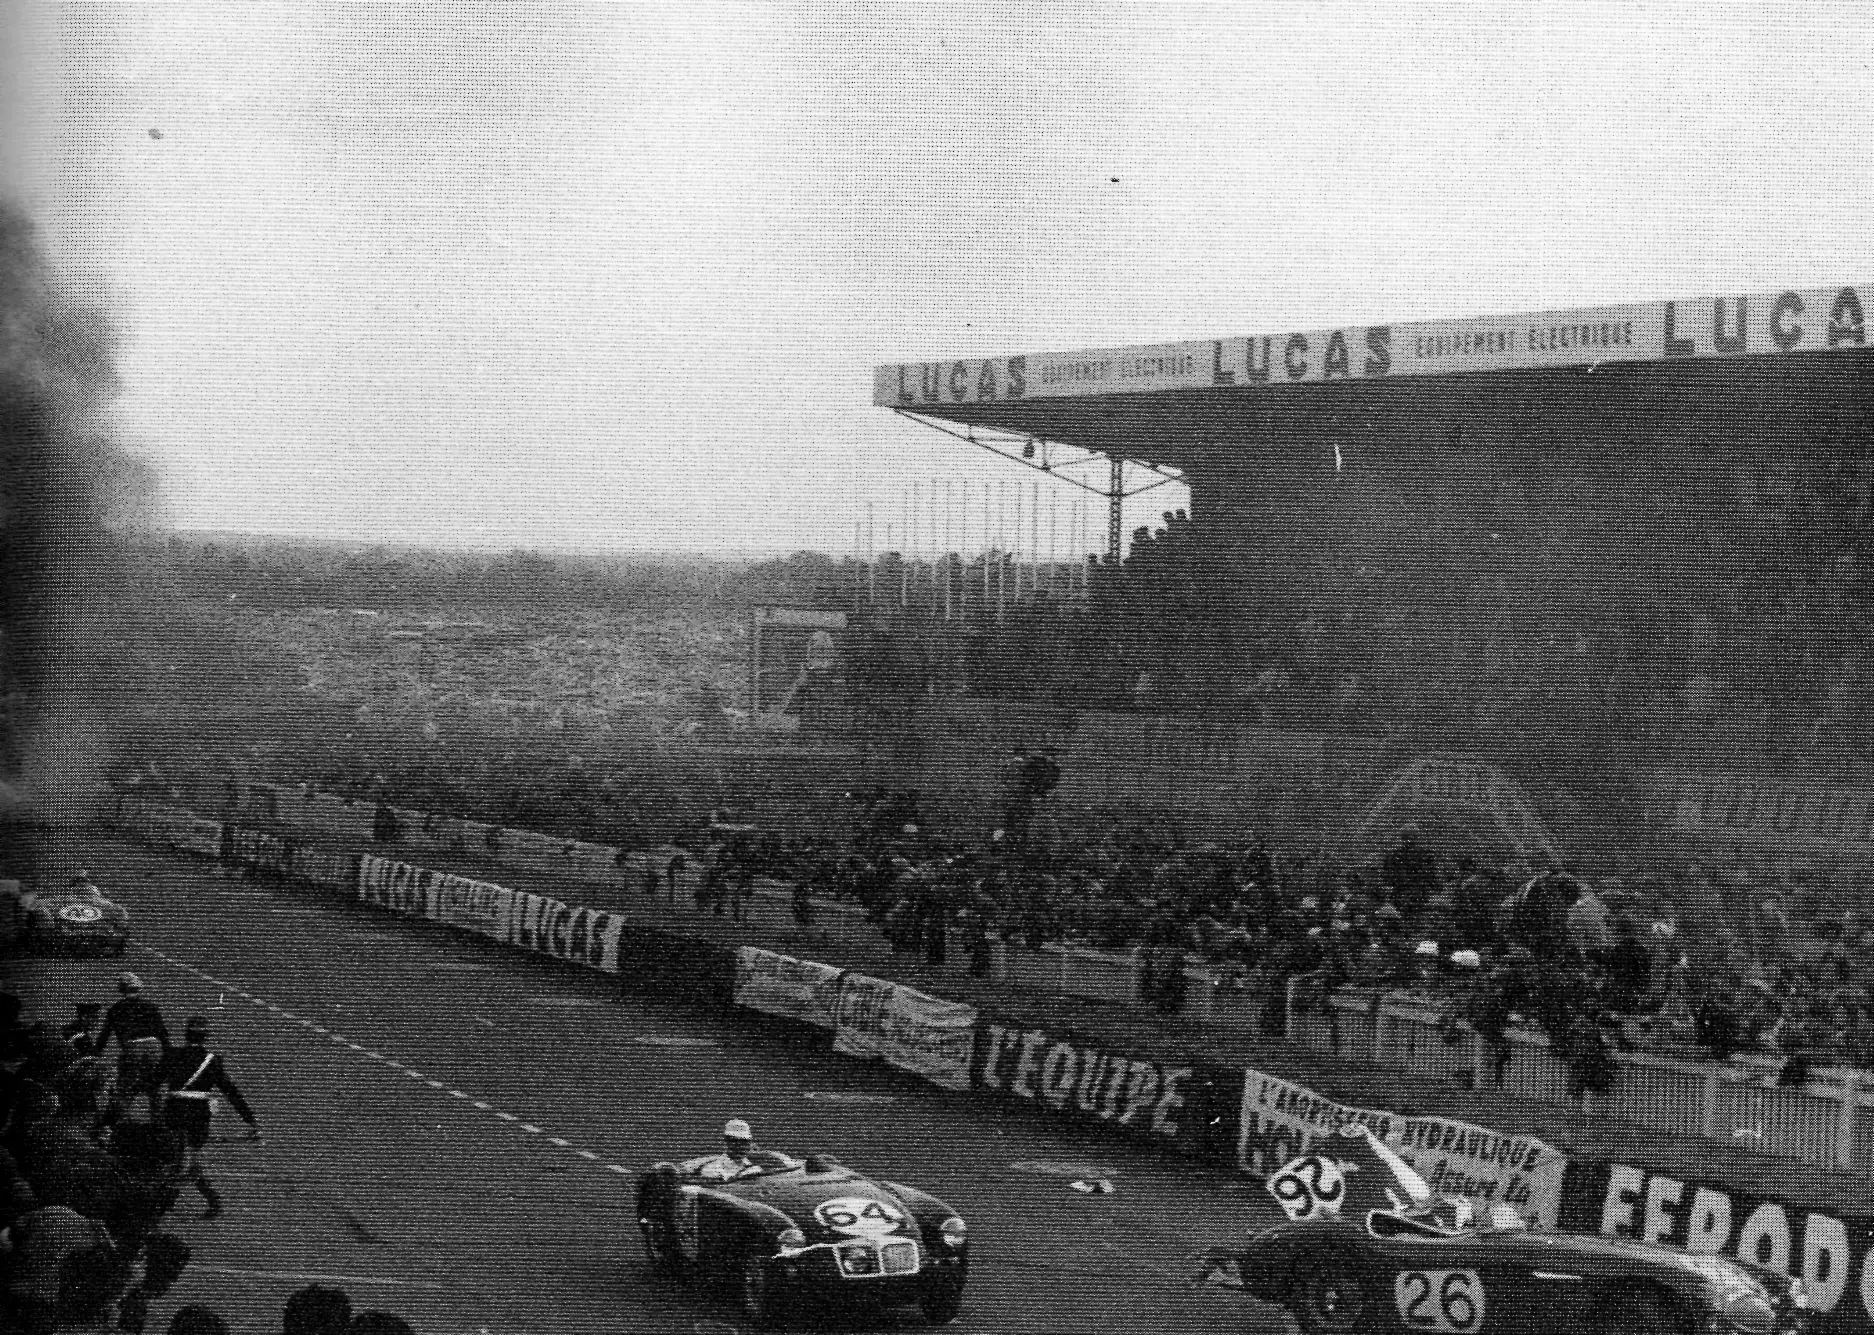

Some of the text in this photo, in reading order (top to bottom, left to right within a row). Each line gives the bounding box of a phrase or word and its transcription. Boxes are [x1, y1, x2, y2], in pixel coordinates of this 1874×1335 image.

[898, 355, 1027, 401] LUCAS
[1212, 325, 1392, 385] LUCAS
[519, 893, 610, 968] LUCAS
[1403, 1119, 1540, 1172] HYDRAULIQUE
[819, 1202, 897, 1227] 64
[1403, 1271, 1476, 1329] 26
